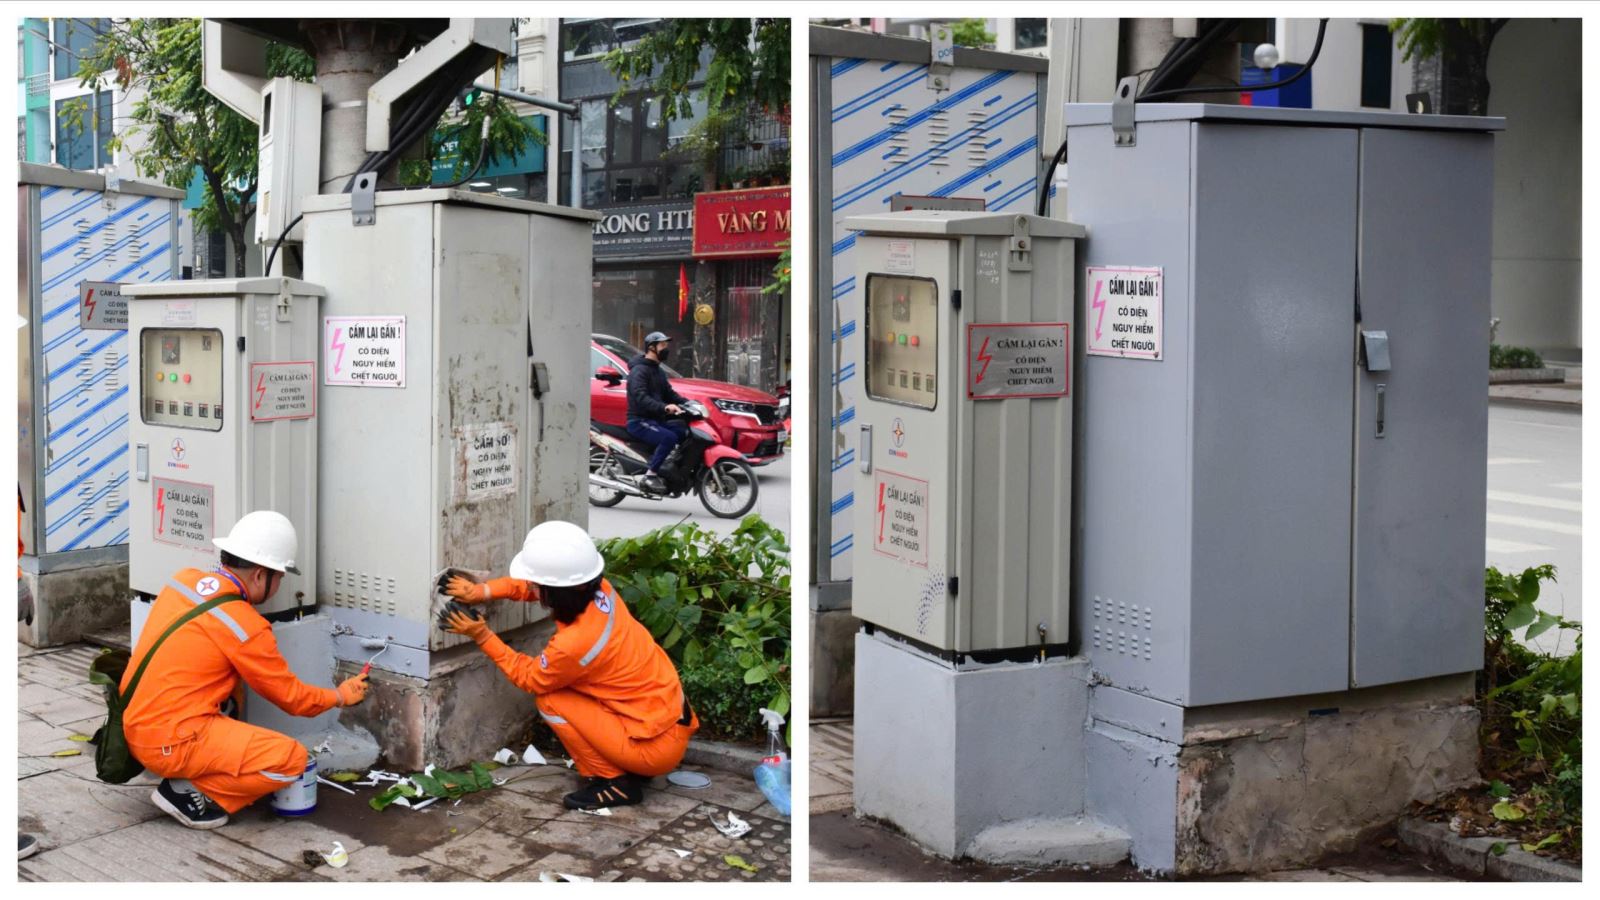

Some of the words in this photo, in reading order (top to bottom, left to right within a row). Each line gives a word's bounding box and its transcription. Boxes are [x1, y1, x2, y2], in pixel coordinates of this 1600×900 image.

[592, 213, 650, 235] KONG
[716, 206, 766, 233] VÀNG
[1109, 274, 1124, 295] CẤM
[1126, 280, 1137, 299] LẠI
[1156, 282, 1158, 296] !
[1118, 305, 1128, 316] CÓ
[1130, 306, 1148, 319] ĐIỆN
[349, 323, 365, 339] CẤM
[367, 327, 378, 341] LẠI
[398, 327, 400, 338] !
[1113, 324, 1133, 333] NGUY
[1021, 340, 1036, 350] LẠI
[1112, 337, 1130, 348] CHẾT
[1132, 340, 1155, 350] NGƯỜI
[358, 346, 369, 355] CÓ
[371, 347, 389, 356] ĐIỆN
[351, 370, 370, 379] CHẾT
[372, 372, 397, 380] NGƯỜI
[474, 433, 493, 450] CẤM
[471, 479, 488, 490] CHẾT
